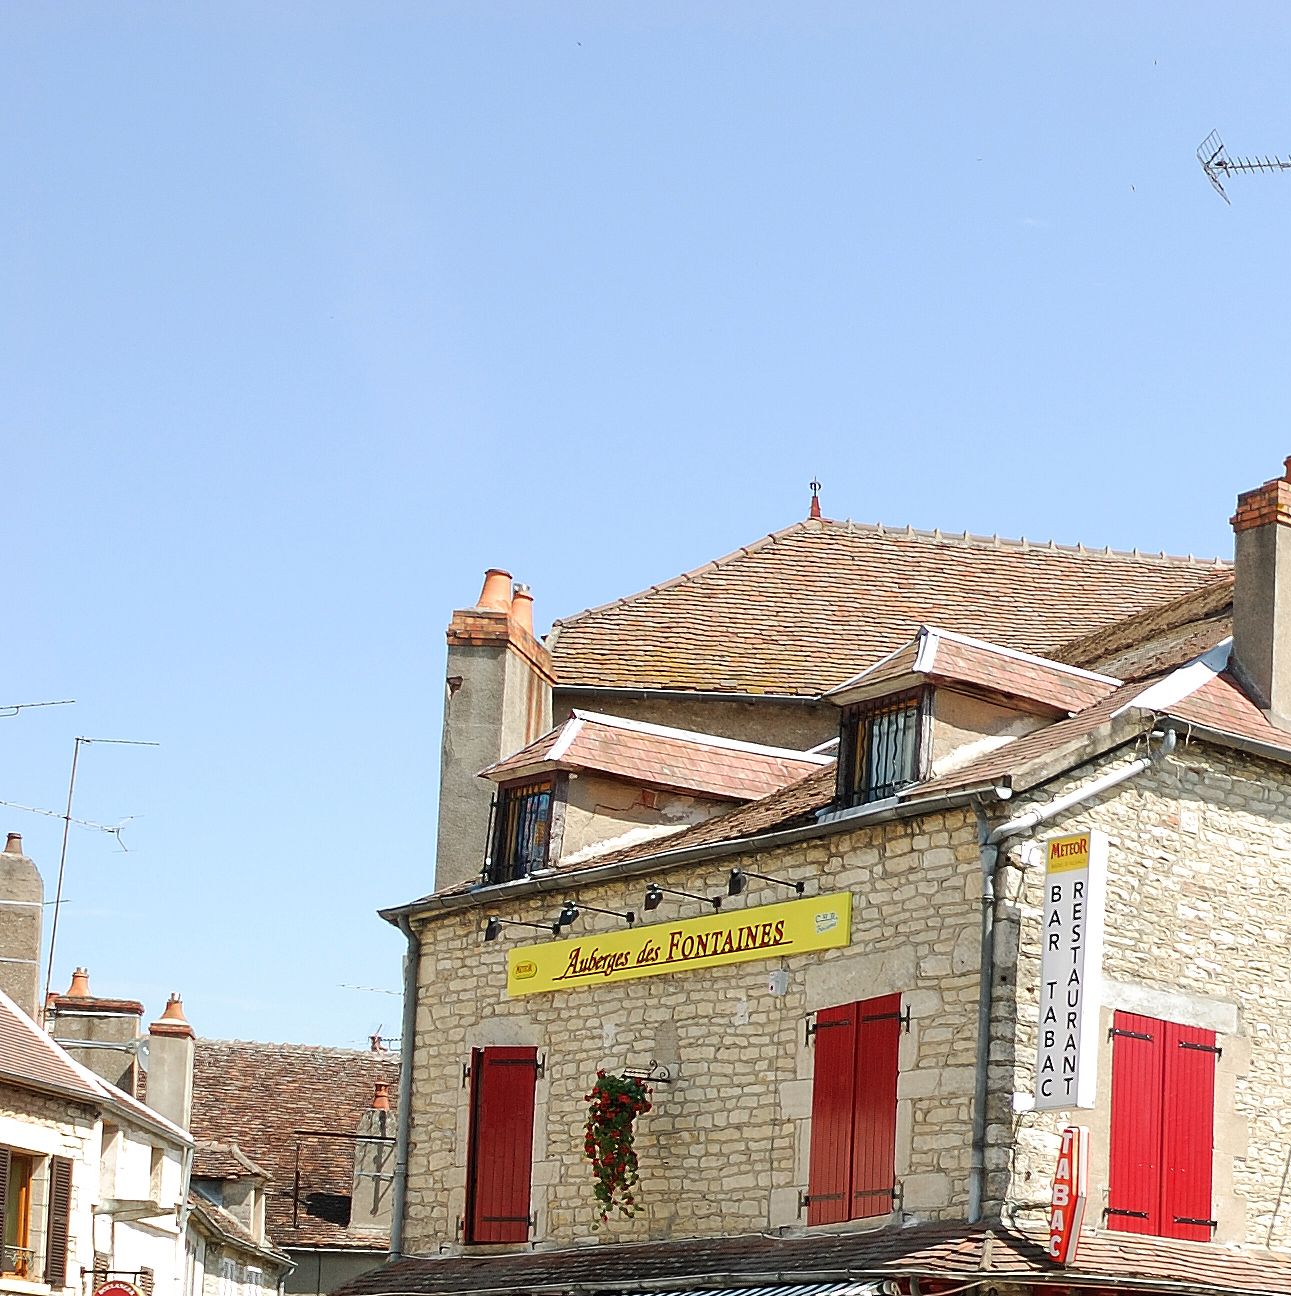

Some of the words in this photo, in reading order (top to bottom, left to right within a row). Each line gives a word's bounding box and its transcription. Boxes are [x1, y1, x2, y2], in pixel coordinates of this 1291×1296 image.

[1050, 838, 1088, 860] METEOR
[562, 947, 630, 976] Auberges
[636, 940, 661, 964] des
[666, 920, 785, 961] FONTAINES
[1047, 885, 1062, 951] BAR
[1063, 881, 1085, 1096] RESTAURANT
[1041, 981, 1058, 1097] TABAC
[1050, 1132, 1073, 1257] TABAC
